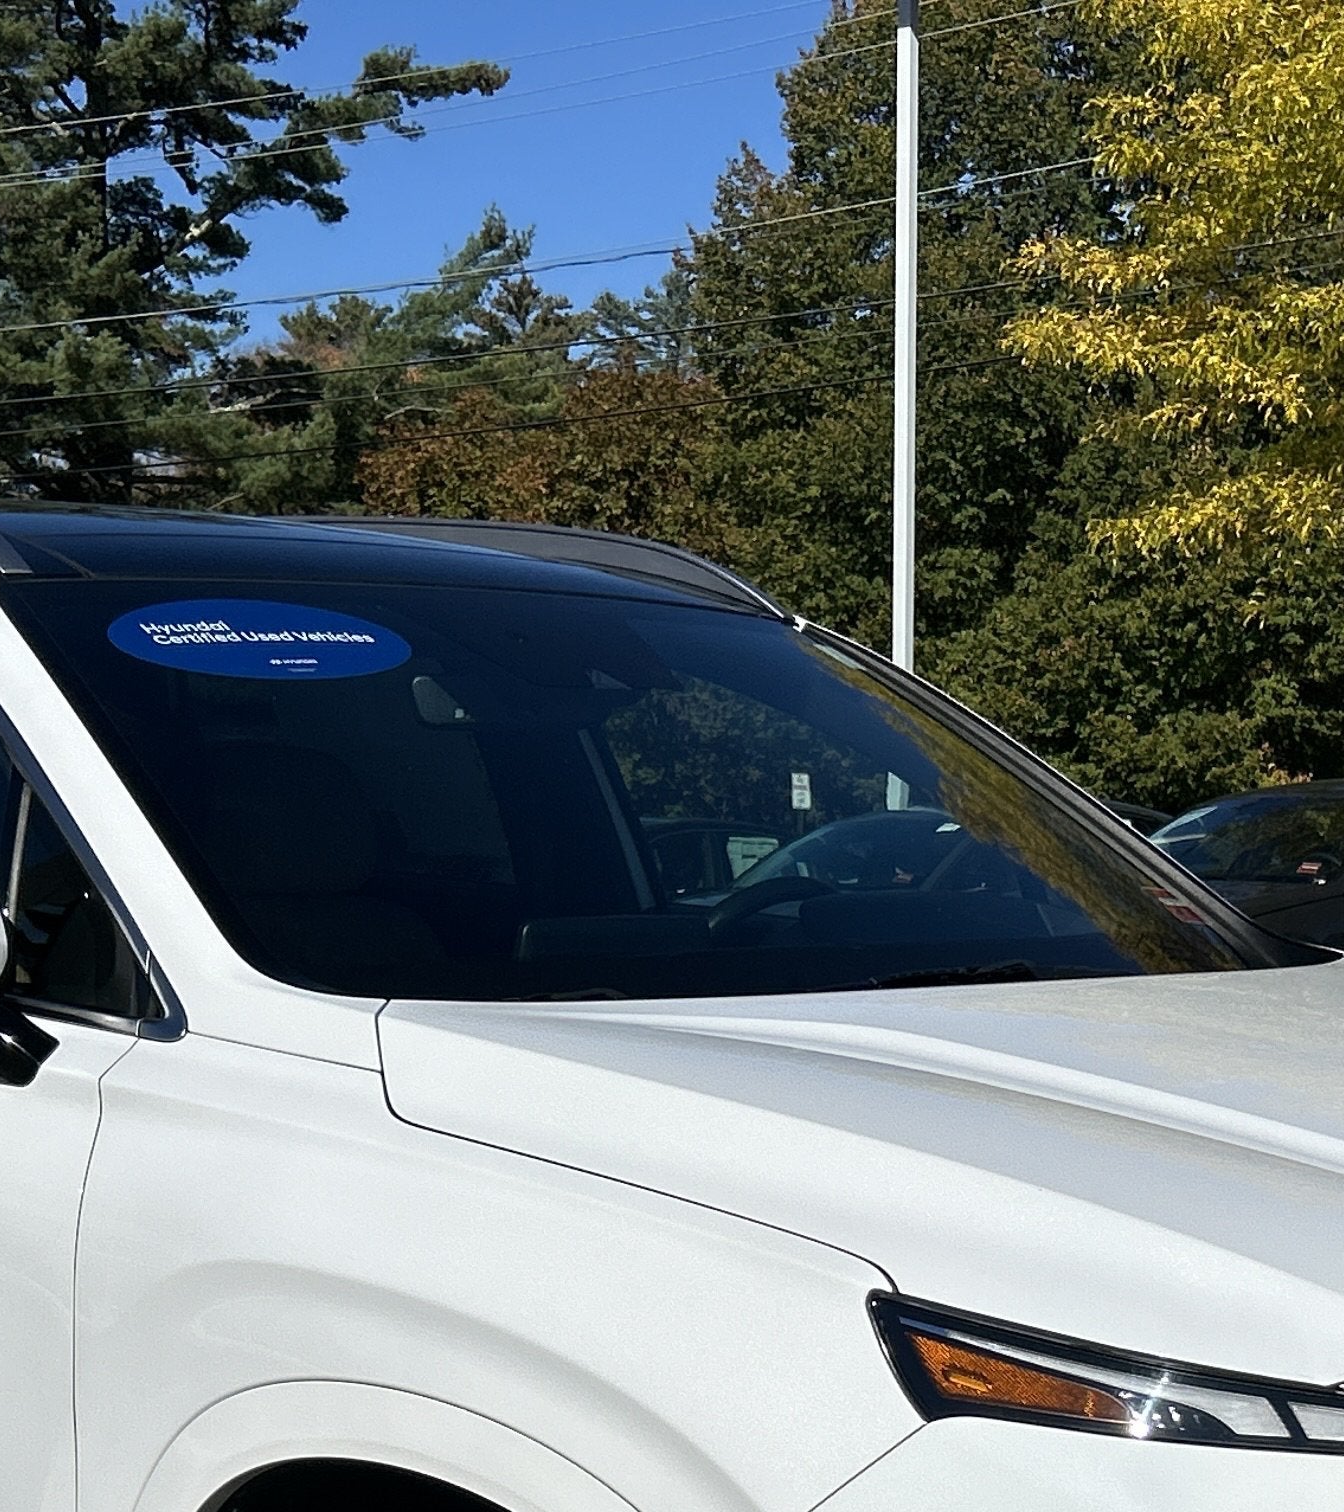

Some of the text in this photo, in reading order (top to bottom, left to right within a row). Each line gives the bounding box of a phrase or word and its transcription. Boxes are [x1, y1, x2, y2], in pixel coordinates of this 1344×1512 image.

[139, 619, 231, 635] Hyundai
[152, 630, 376, 645] Certified Used Vehicles
